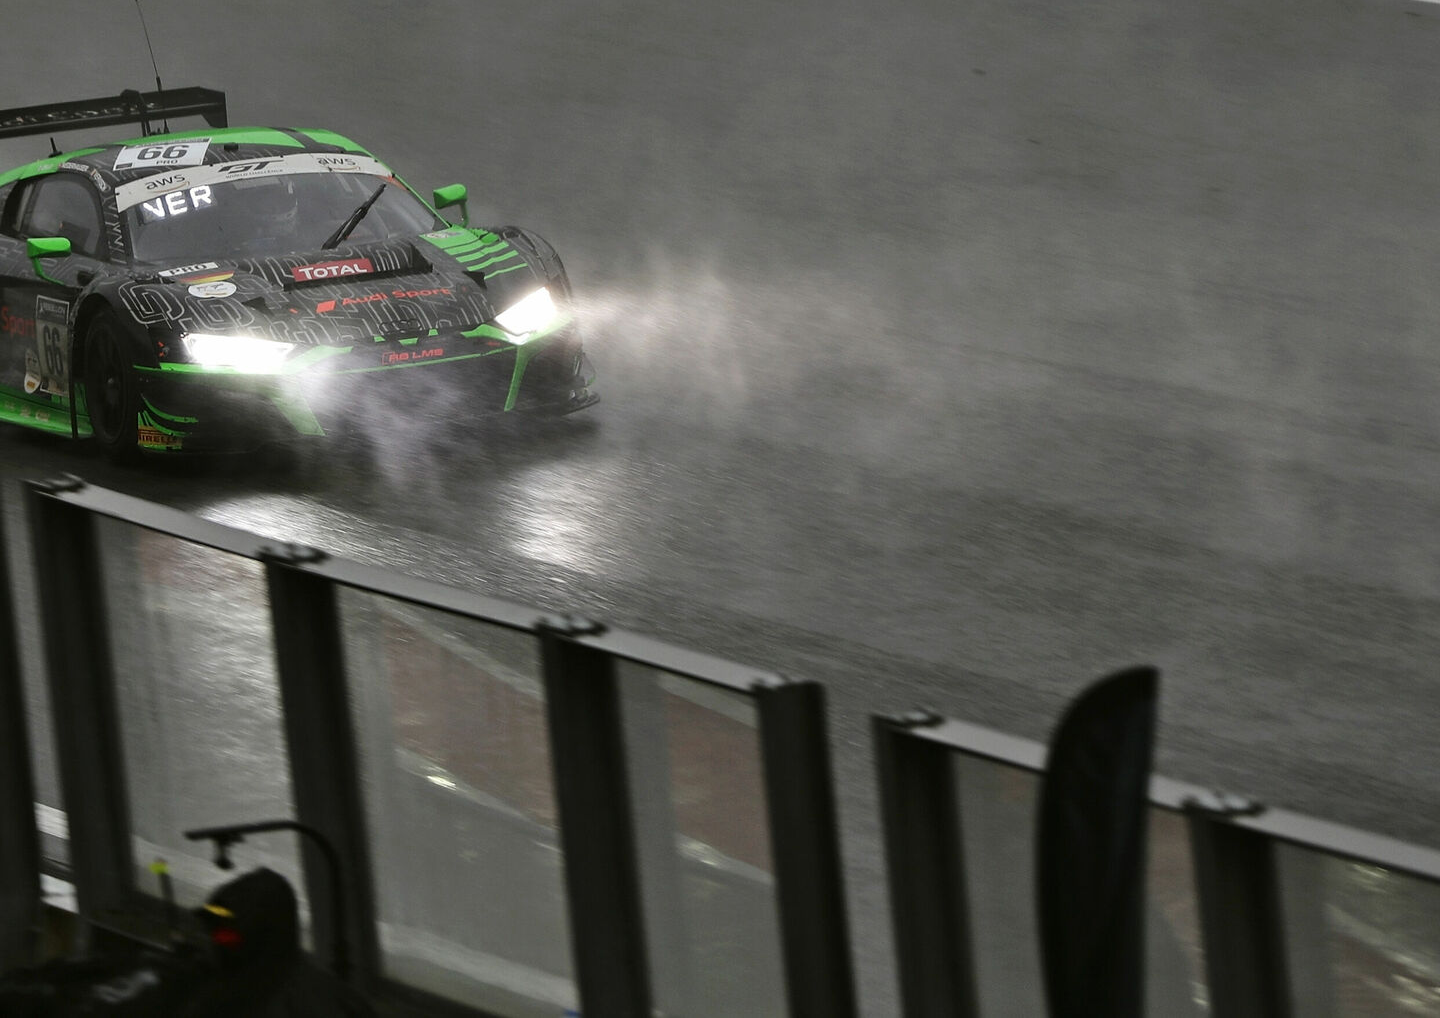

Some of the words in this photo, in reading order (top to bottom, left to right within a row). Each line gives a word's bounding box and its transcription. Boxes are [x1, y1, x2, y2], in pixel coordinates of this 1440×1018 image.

[137, 145, 189, 160] 66
[317, 156, 356, 167] aws
[146, 174, 186, 190] aws
[168, 264, 208, 275] PRO
[298, 262, 368, 281] TOTAL
[342, 293, 387, 305] Audi
[392, 289, 451, 298] Sport
[42, 324, 64, 379] 66
[412, 348, 444, 360] LMS
